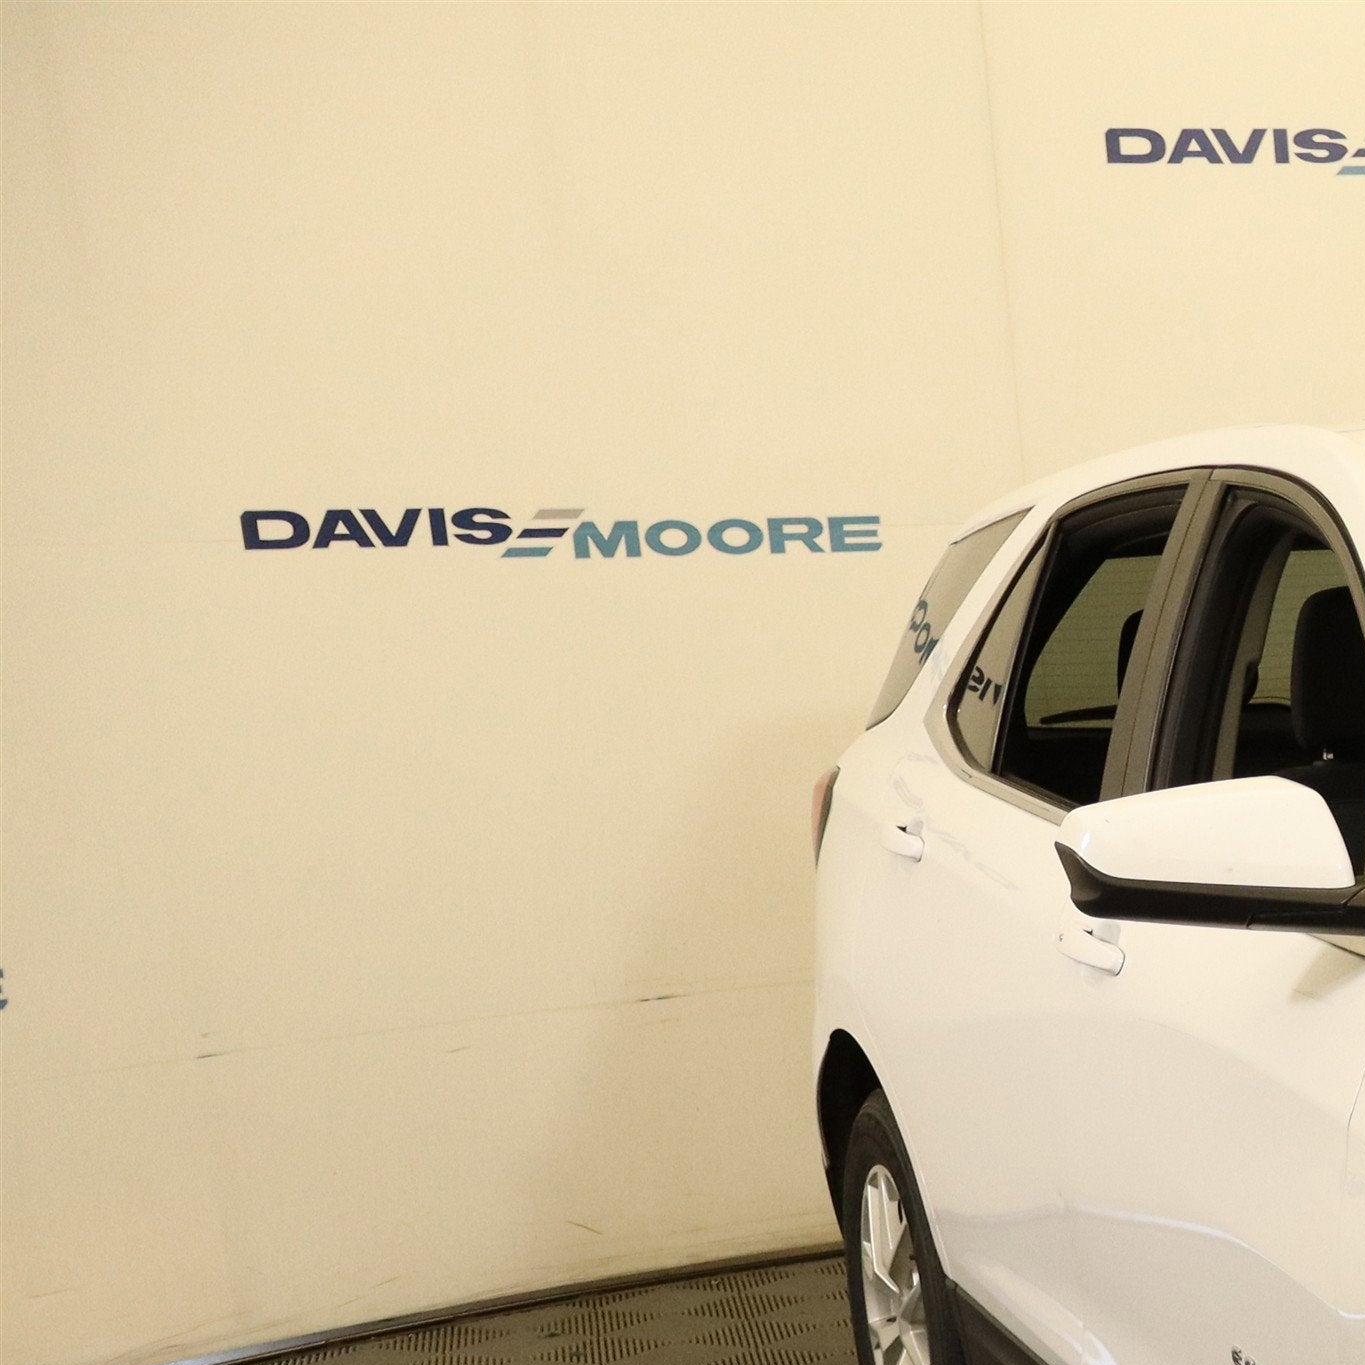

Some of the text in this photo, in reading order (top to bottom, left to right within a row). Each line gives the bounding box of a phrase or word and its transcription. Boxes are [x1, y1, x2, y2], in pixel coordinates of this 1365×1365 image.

[1104, 127, 1349, 164] DAVIS
[240, 507, 882, 559] DAVIS MOORE
